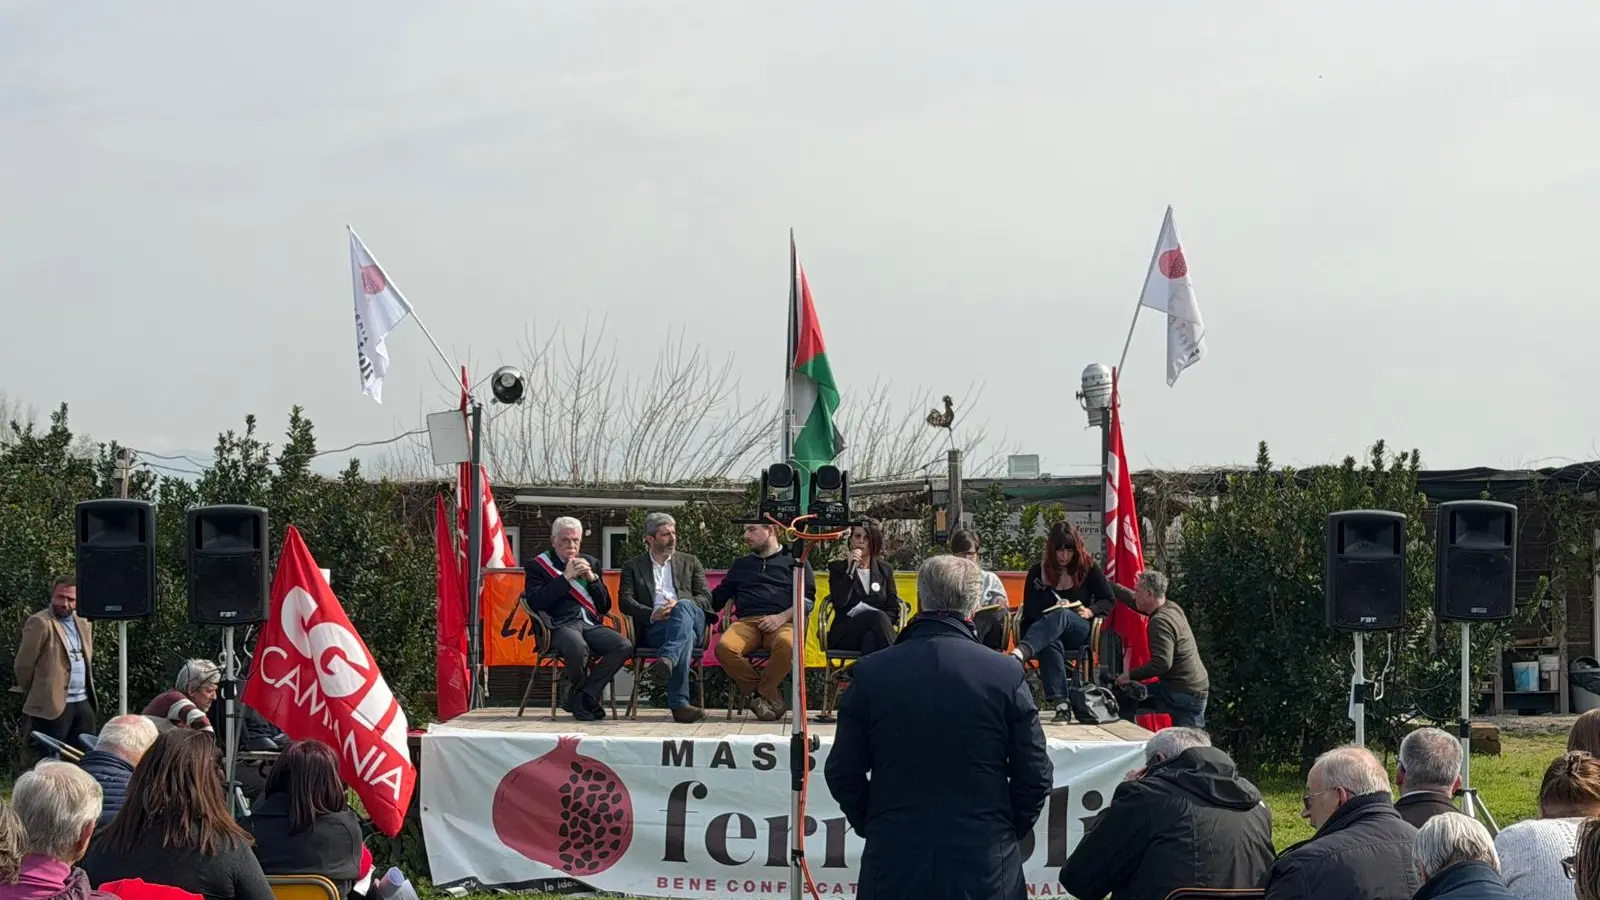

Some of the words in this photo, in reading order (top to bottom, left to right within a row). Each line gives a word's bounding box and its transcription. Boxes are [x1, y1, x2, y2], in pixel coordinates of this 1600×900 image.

[281, 586, 411, 767] CGIL
[657, 877, 716, 892] BENE
[726, 880, 859, 895] CONFSCAT
